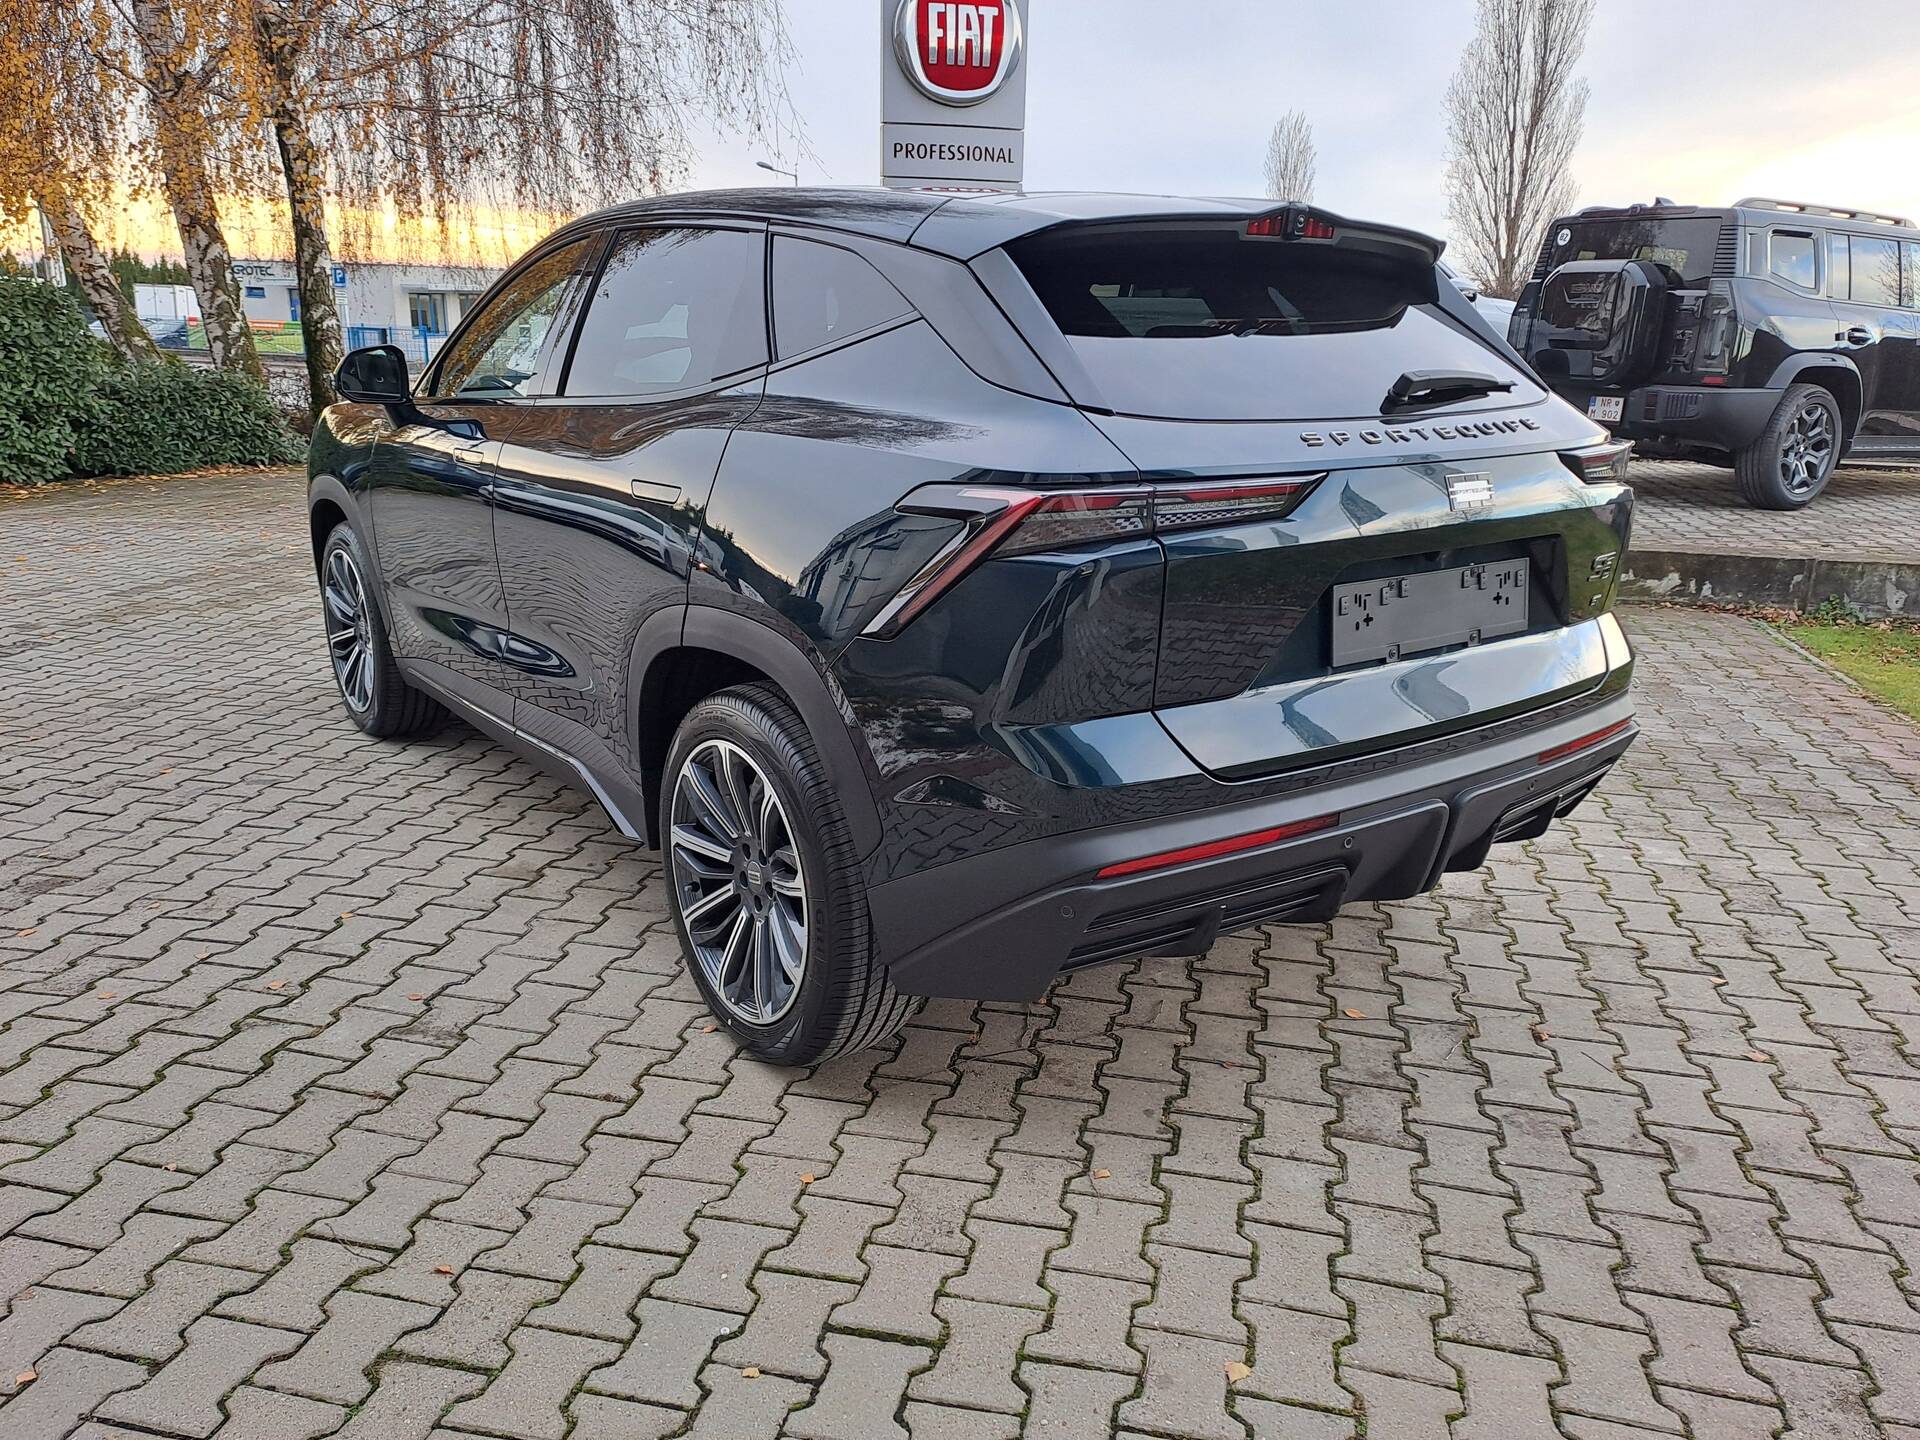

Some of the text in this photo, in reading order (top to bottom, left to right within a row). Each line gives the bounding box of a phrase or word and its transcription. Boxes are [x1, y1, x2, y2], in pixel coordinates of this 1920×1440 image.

[928, 3, 998, 67] FIAT
[893, 142, 1015, 163] PROFESSIONAL
[1601, 398, 1612, 407] NR
[1601, 410, 1619, 420] 902
[1300, 418, 1540, 447] SPORTEQUIPE
